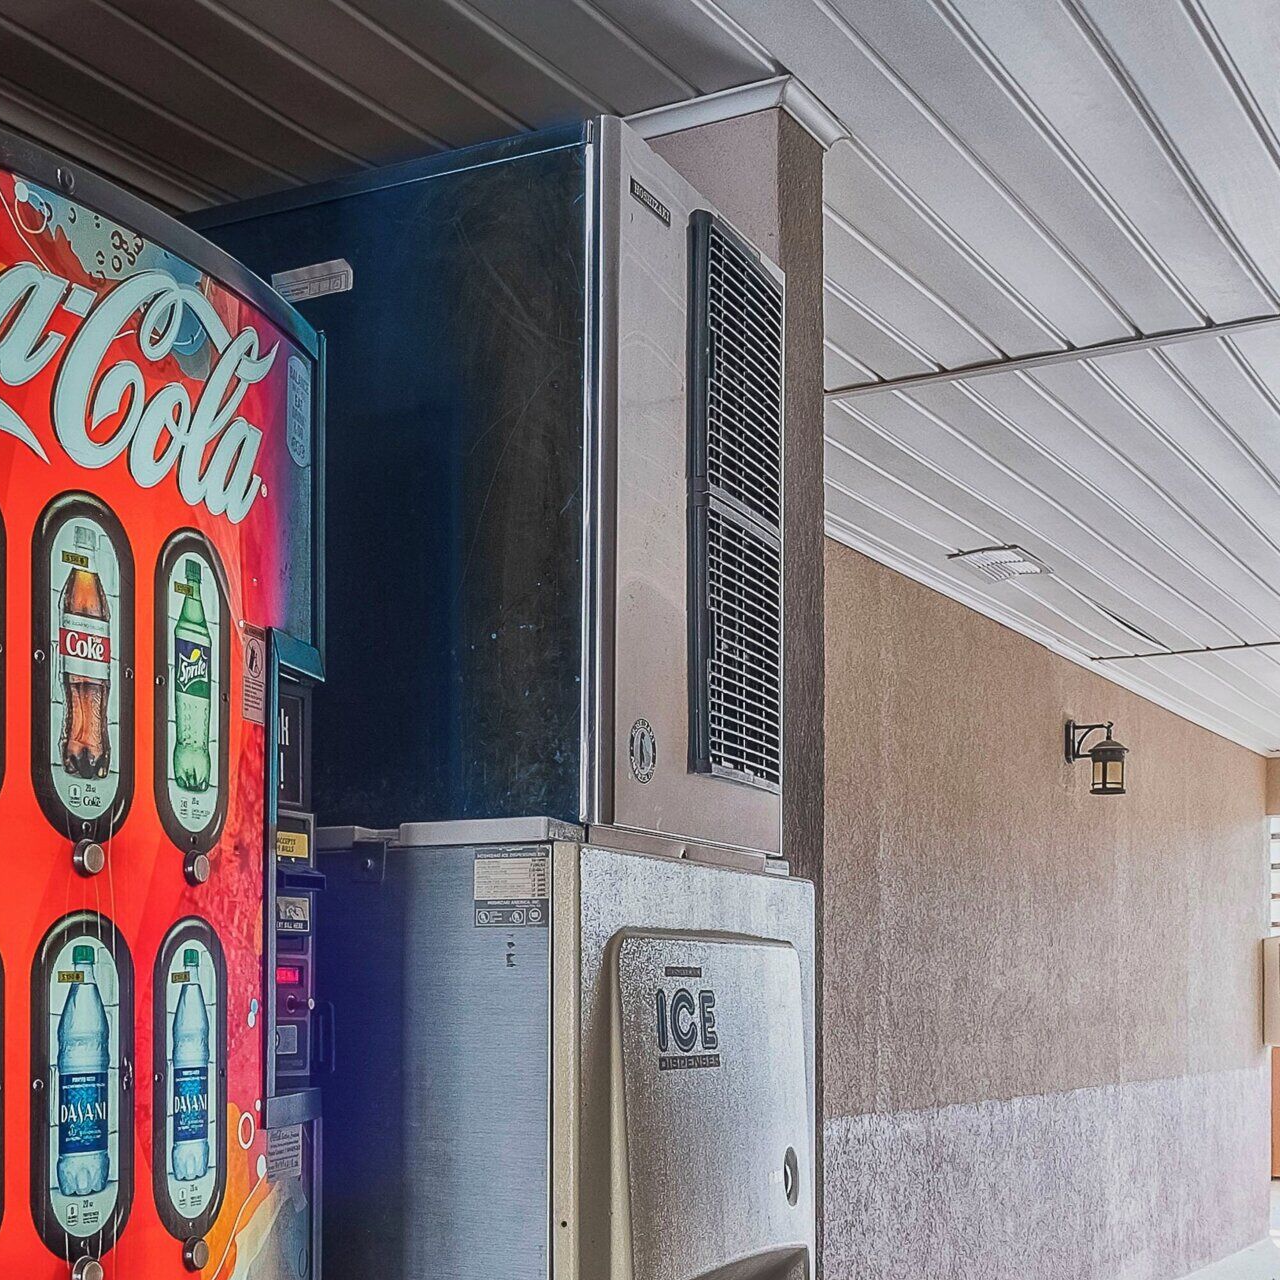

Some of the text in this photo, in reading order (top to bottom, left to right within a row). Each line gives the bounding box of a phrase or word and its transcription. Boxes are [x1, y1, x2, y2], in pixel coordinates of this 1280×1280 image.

[633, 181, 670, 222] HOSHIZAKI
[66, 631, 104, 660] Coke
[180, 659, 207, 684] Sprite
[656, 988, 718, 1053] ICE
[61, 1101, 106, 1124] DASANI
[175, 1093, 207, 1113] DASANI
